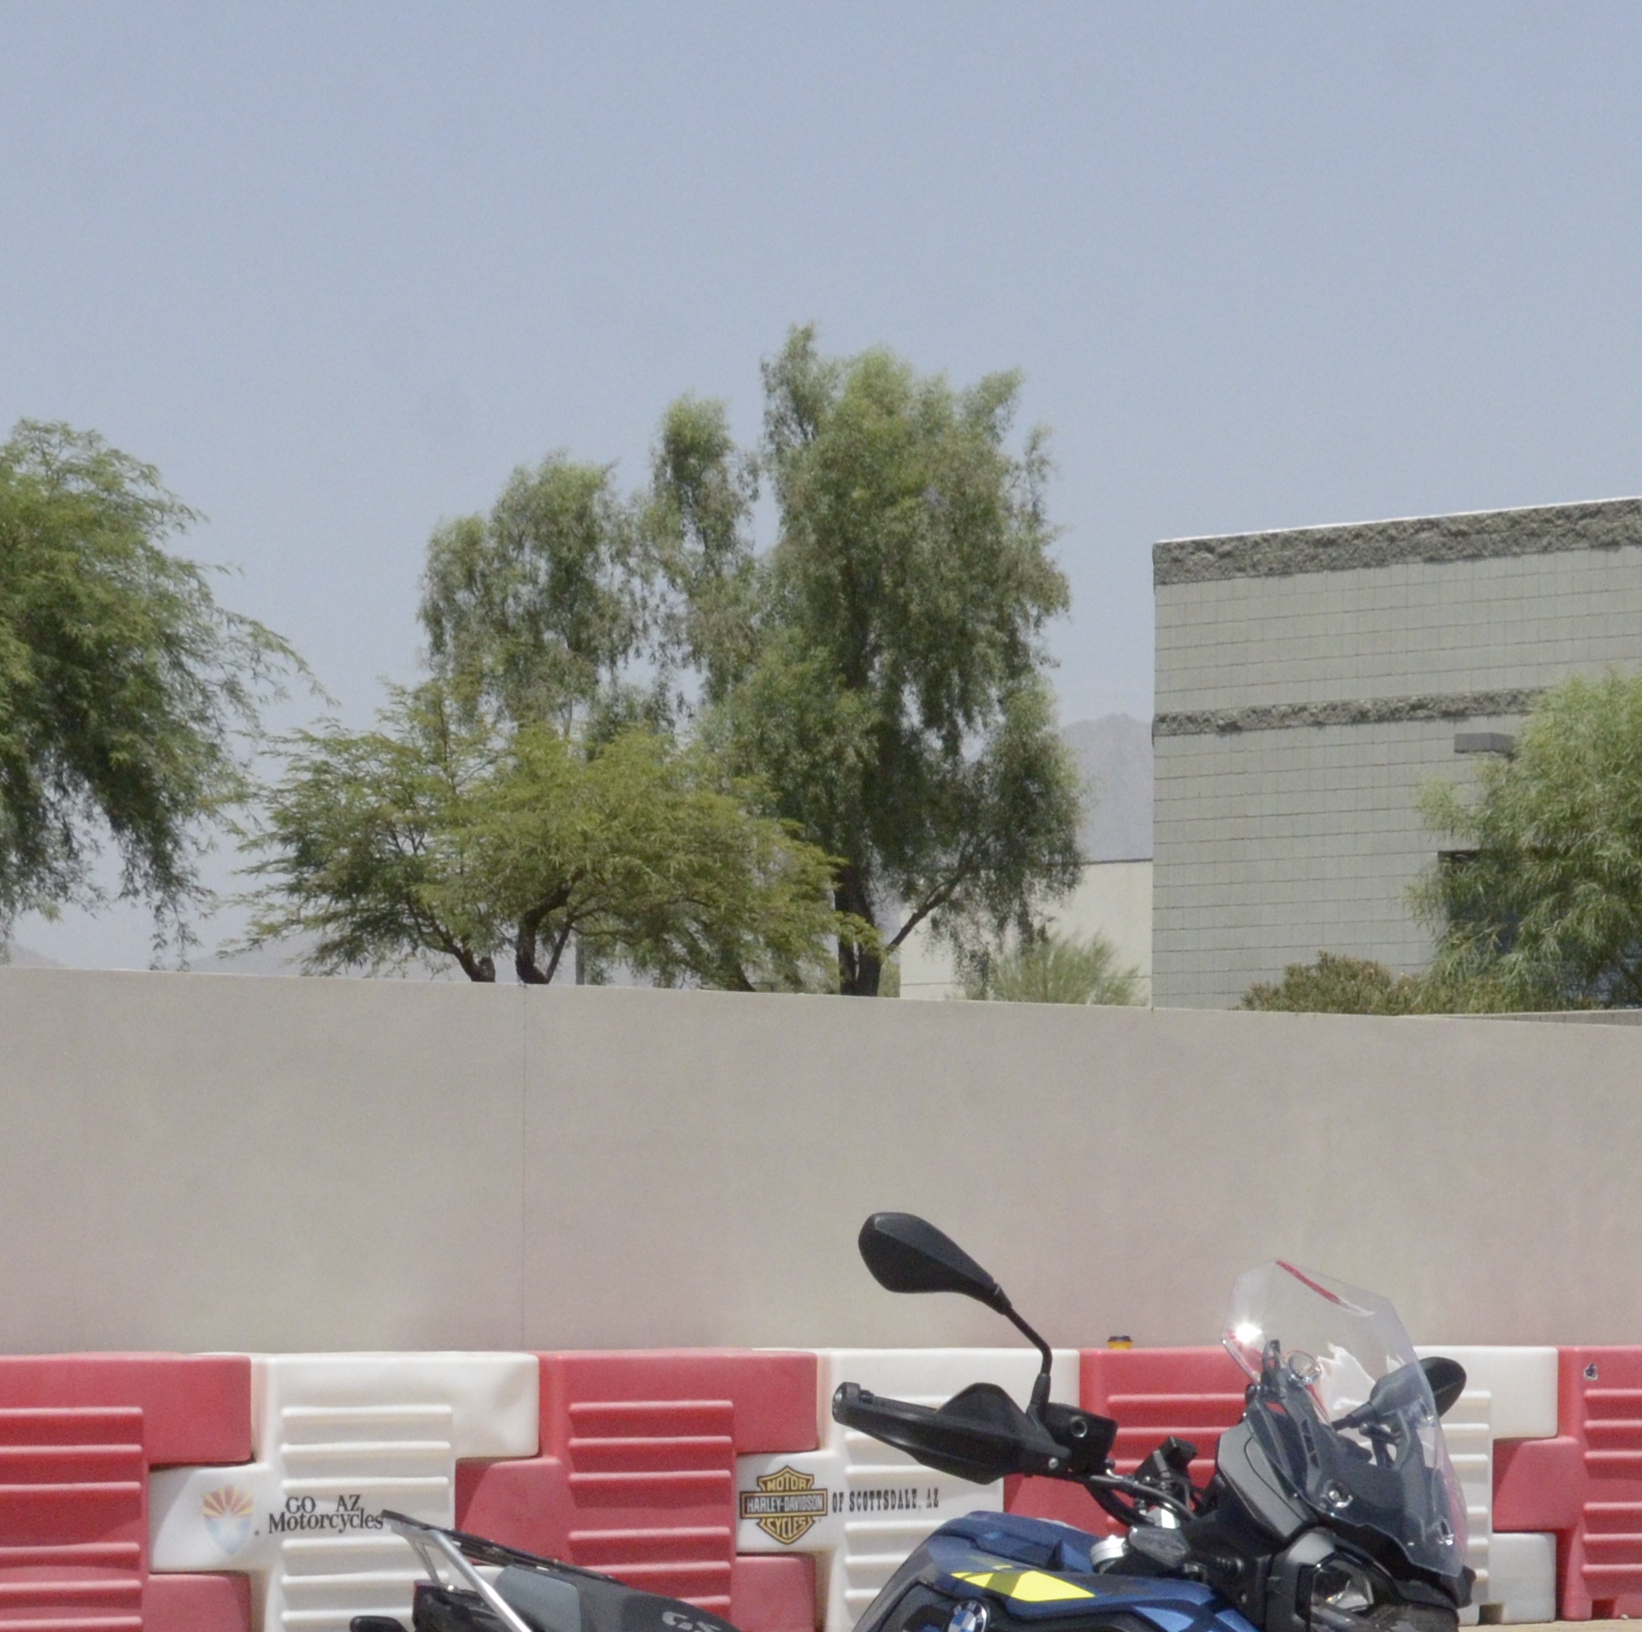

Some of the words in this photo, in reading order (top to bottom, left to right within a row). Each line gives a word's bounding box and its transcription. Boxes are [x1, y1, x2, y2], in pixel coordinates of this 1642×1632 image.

[767, 1473, 807, 1491] MOTOR
[285, 1496, 316, 1514] GO
[336, 1494, 361, 1512] AZ
[832, 1491, 844, 1513] OF
[268, 1508, 384, 1533] Motorcycles
[767, 1517, 806, 1538] CYCLES
